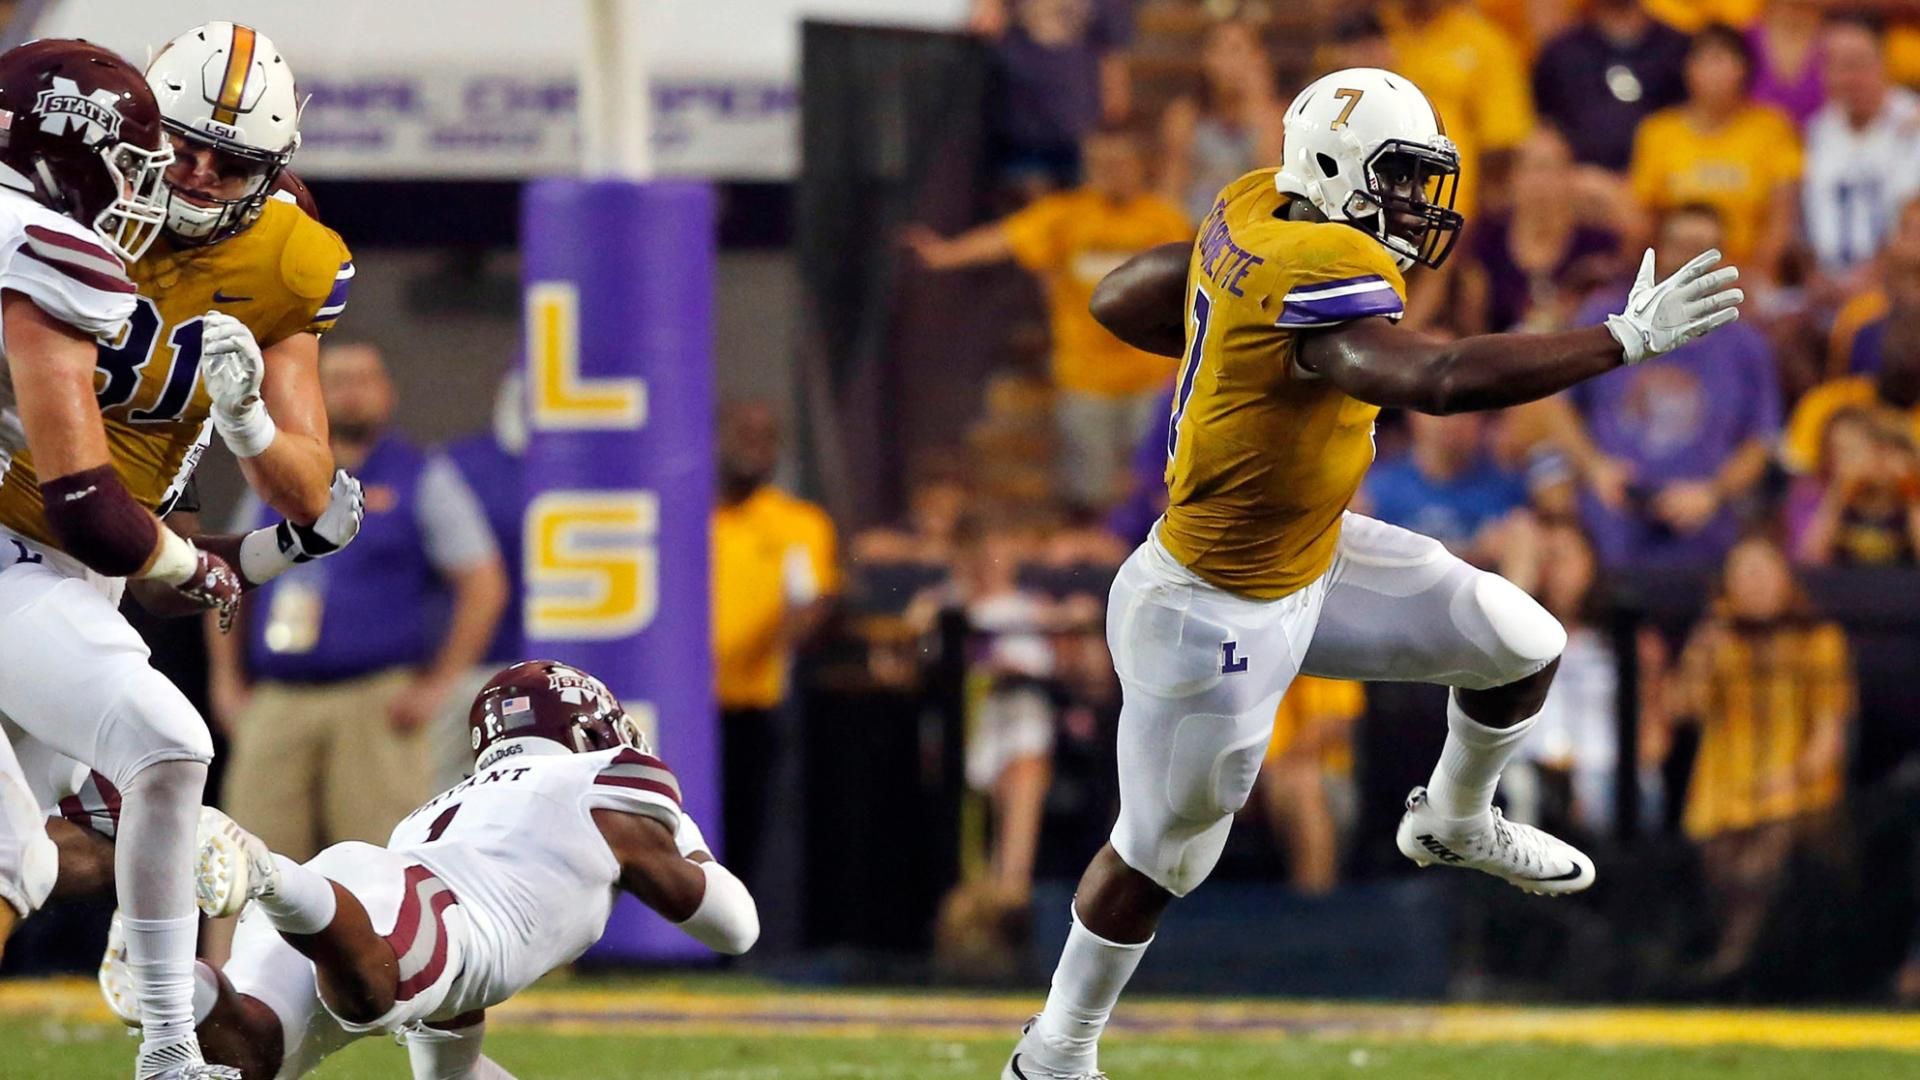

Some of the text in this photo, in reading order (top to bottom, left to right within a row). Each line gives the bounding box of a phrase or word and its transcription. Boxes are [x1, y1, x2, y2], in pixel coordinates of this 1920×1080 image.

[48, 97, 110, 128] STATE
[1330, 88, 1365, 131] 7
[209, 122, 236, 139] LSU
[524, 281, 657, 755] LS
[10, 539, 43, 564] L
[1221, 640, 1249, 674] L
[421, 802, 462, 843] 1
[1416, 834, 1464, 862] NIKE
